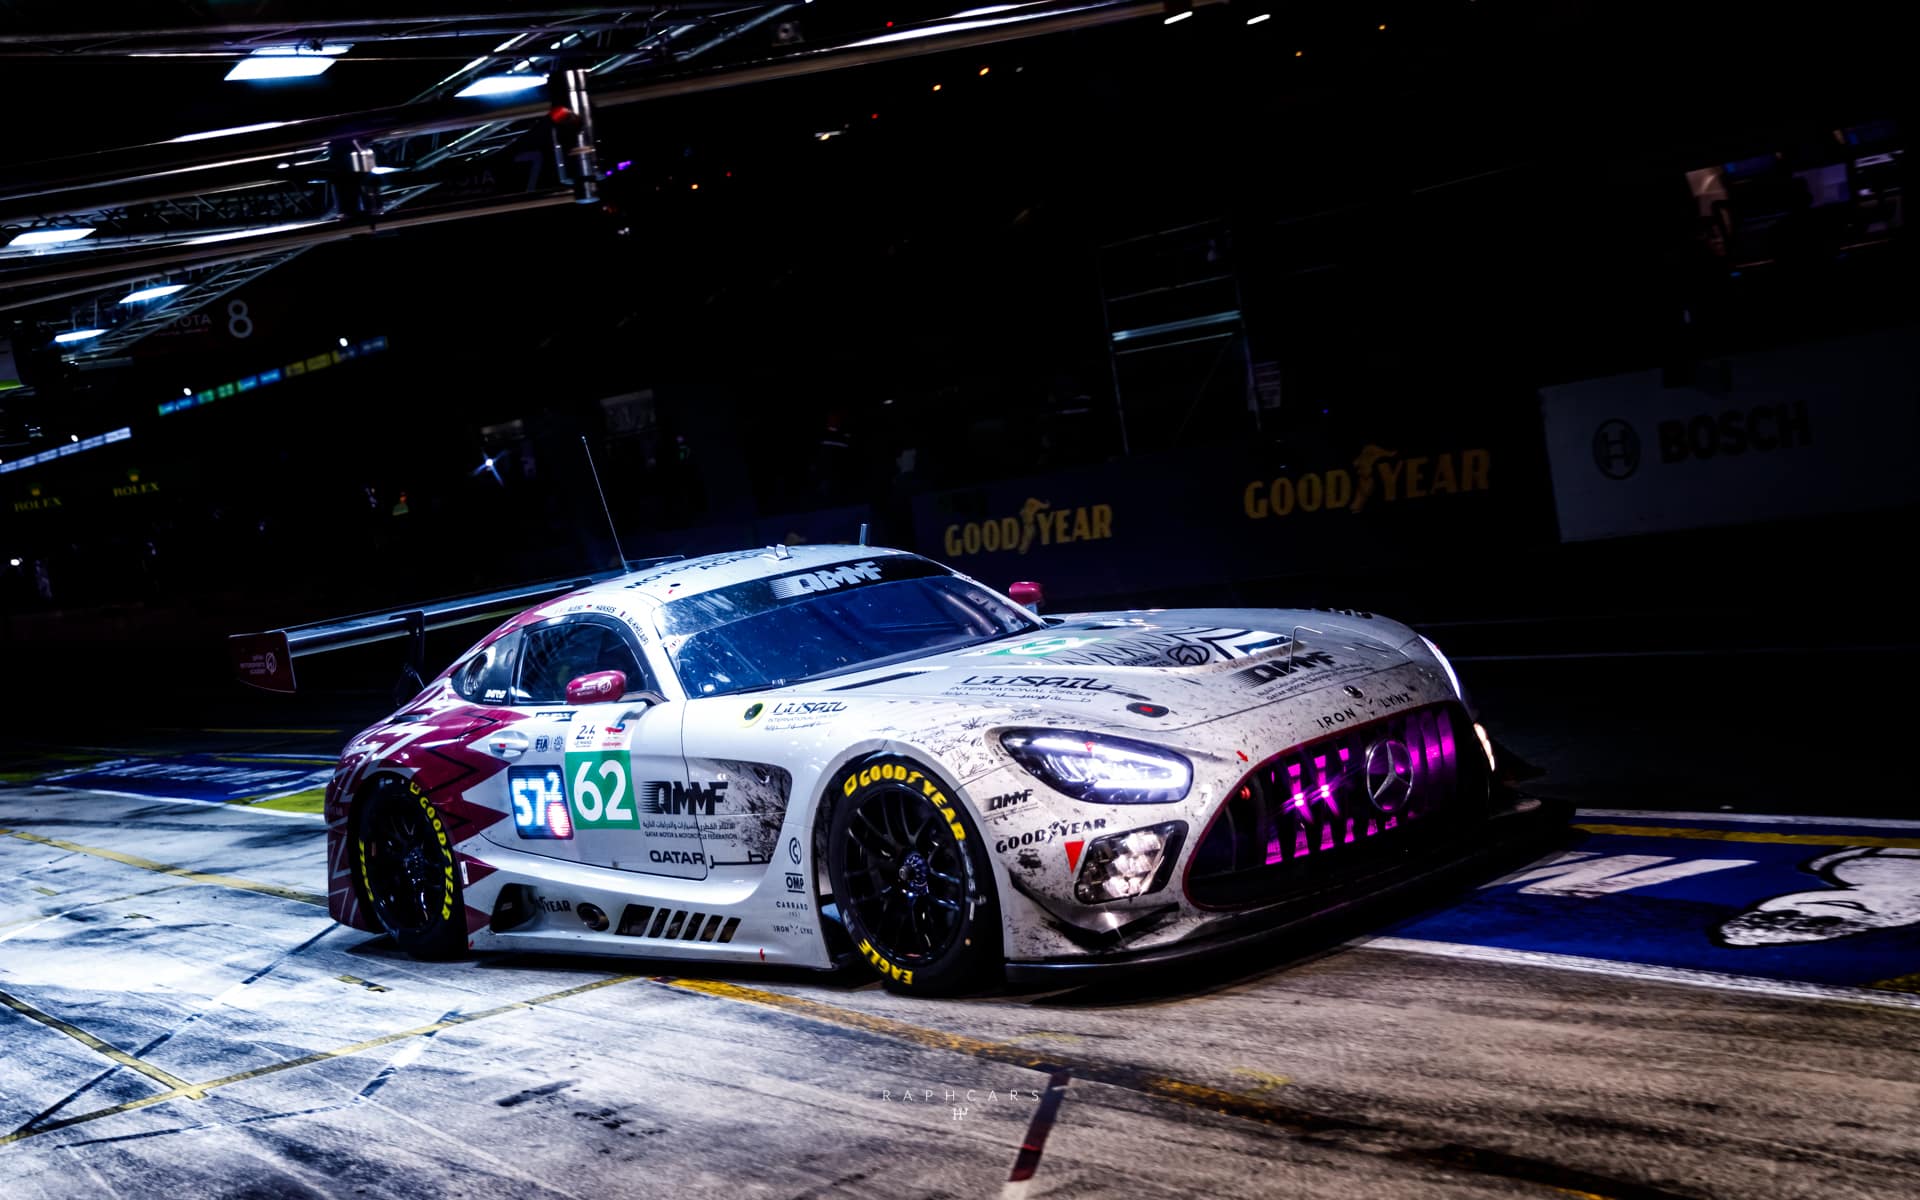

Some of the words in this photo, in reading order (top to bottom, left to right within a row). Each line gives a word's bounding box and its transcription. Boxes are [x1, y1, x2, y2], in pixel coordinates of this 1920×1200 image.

[227, 298, 254, 339] 8
[1660, 400, 1811, 464] BOSCH
[112, 481, 160, 497] ROLEX
[768, 561, 882, 600] QMMF
[1231, 650, 1335, 688] QMMF
[1316, 708, 1357, 728] IRON
[1379, 693, 1413, 708] LYNX
[535, 737, 549, 752] FIA
[573, 760, 633, 822] 62
[641, 781, 729, 816] QMMF
[984, 789, 1034, 811] QMMF
[649, 850, 705, 865] QATAR
[785, 875, 804, 890] OMP
[858, 937, 914, 985] EAGLE
